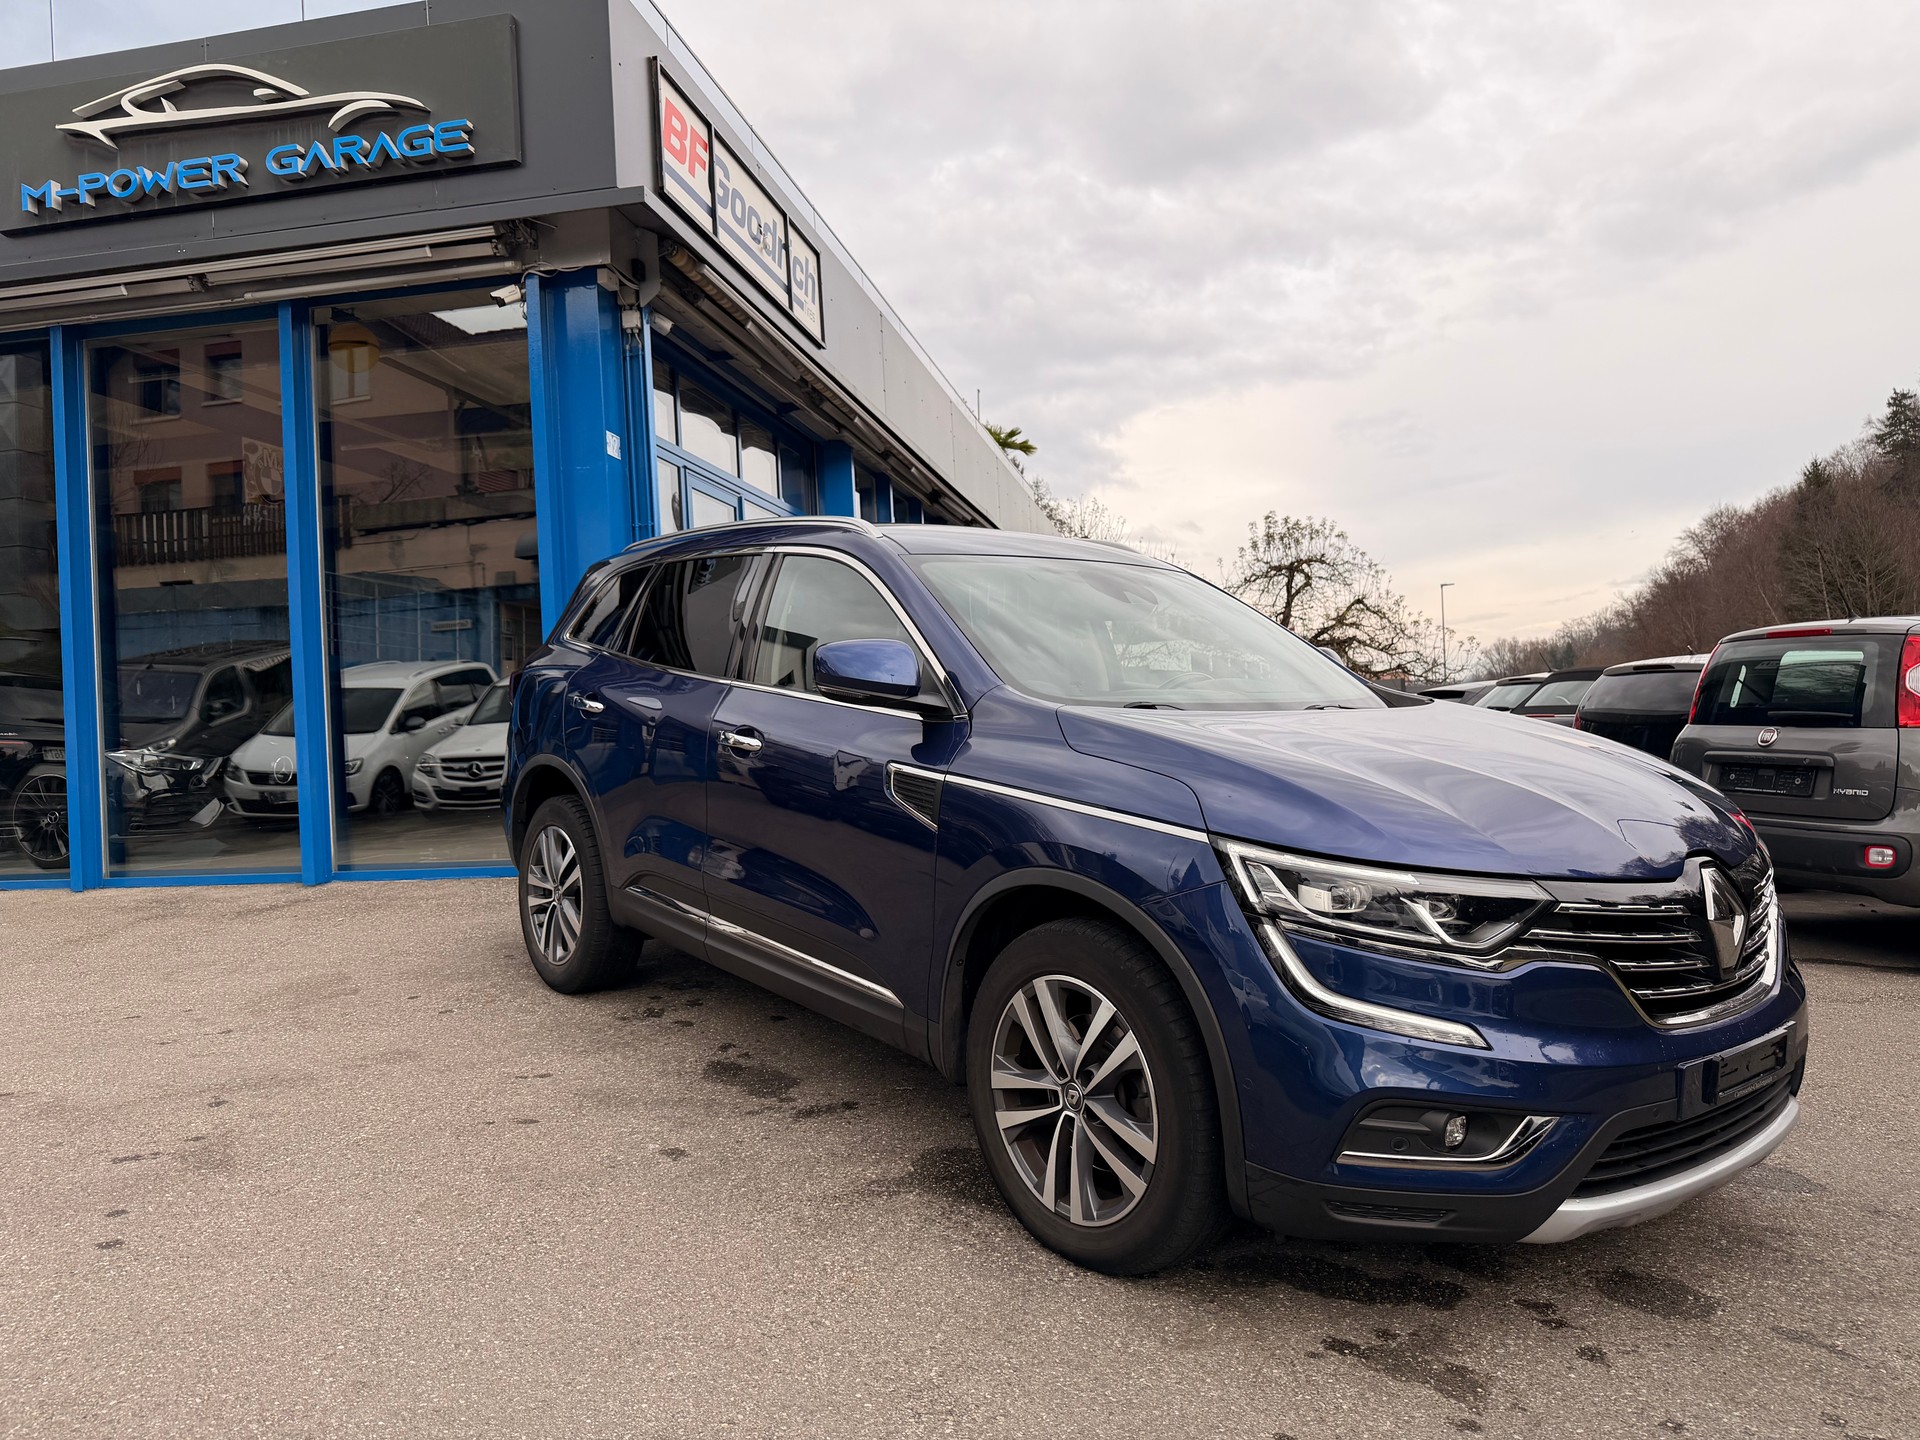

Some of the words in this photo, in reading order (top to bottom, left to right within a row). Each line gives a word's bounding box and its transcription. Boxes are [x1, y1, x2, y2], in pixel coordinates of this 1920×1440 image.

[21, 153, 249, 214] M-POWER
[265, 118, 476, 176] GARAGE
[1833, 788, 1869, 796] HYBRID
